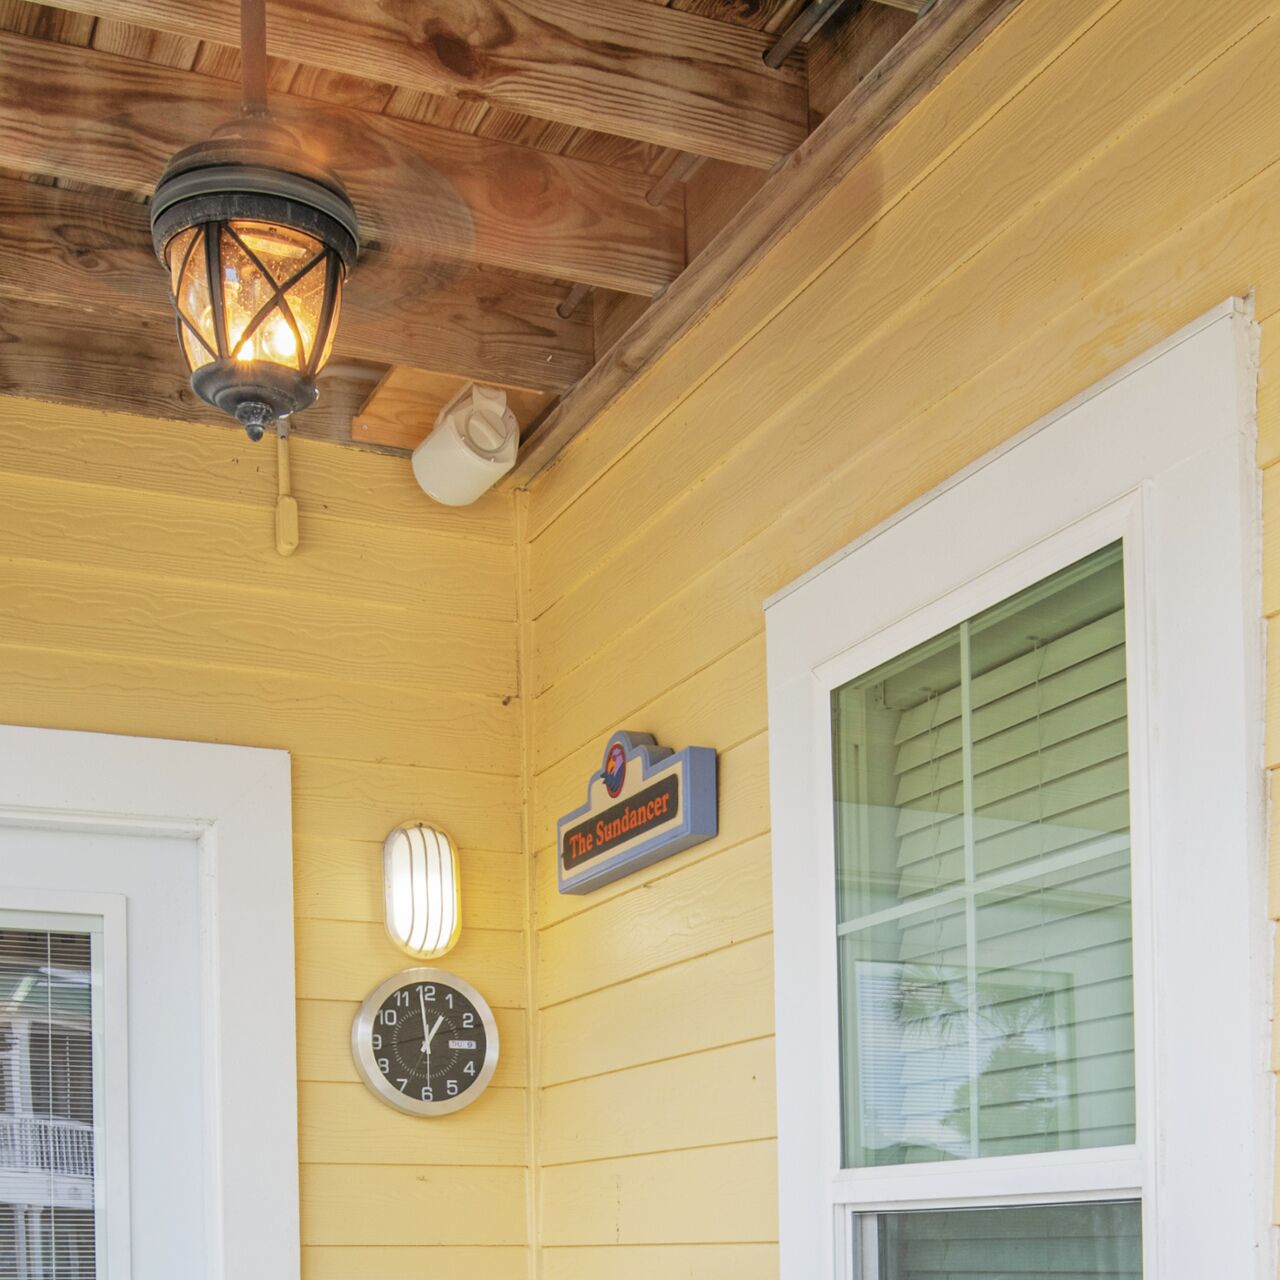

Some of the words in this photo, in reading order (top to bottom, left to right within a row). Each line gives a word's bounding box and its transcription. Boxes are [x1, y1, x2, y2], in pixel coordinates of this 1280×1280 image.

[569, 832, 593, 859] The
[596, 793, 670, 846] Sundancer
[393, 991, 409, 1007] 11
[416, 985, 436, 1001] 12
[445, 993, 453, 1009] 1
[377, 1010, 397, 1026] 10
[462, 1013, 474, 1028] 2
[372, 1034, 382, 1050] 9
[378, 1058, 390, 1074] 8
[463, 1061, 475, 1076] 4
[396, 1078, 408, 1093] 7
[421, 1086, 433, 1101] 6
[446, 1080, 458, 1095] 5
